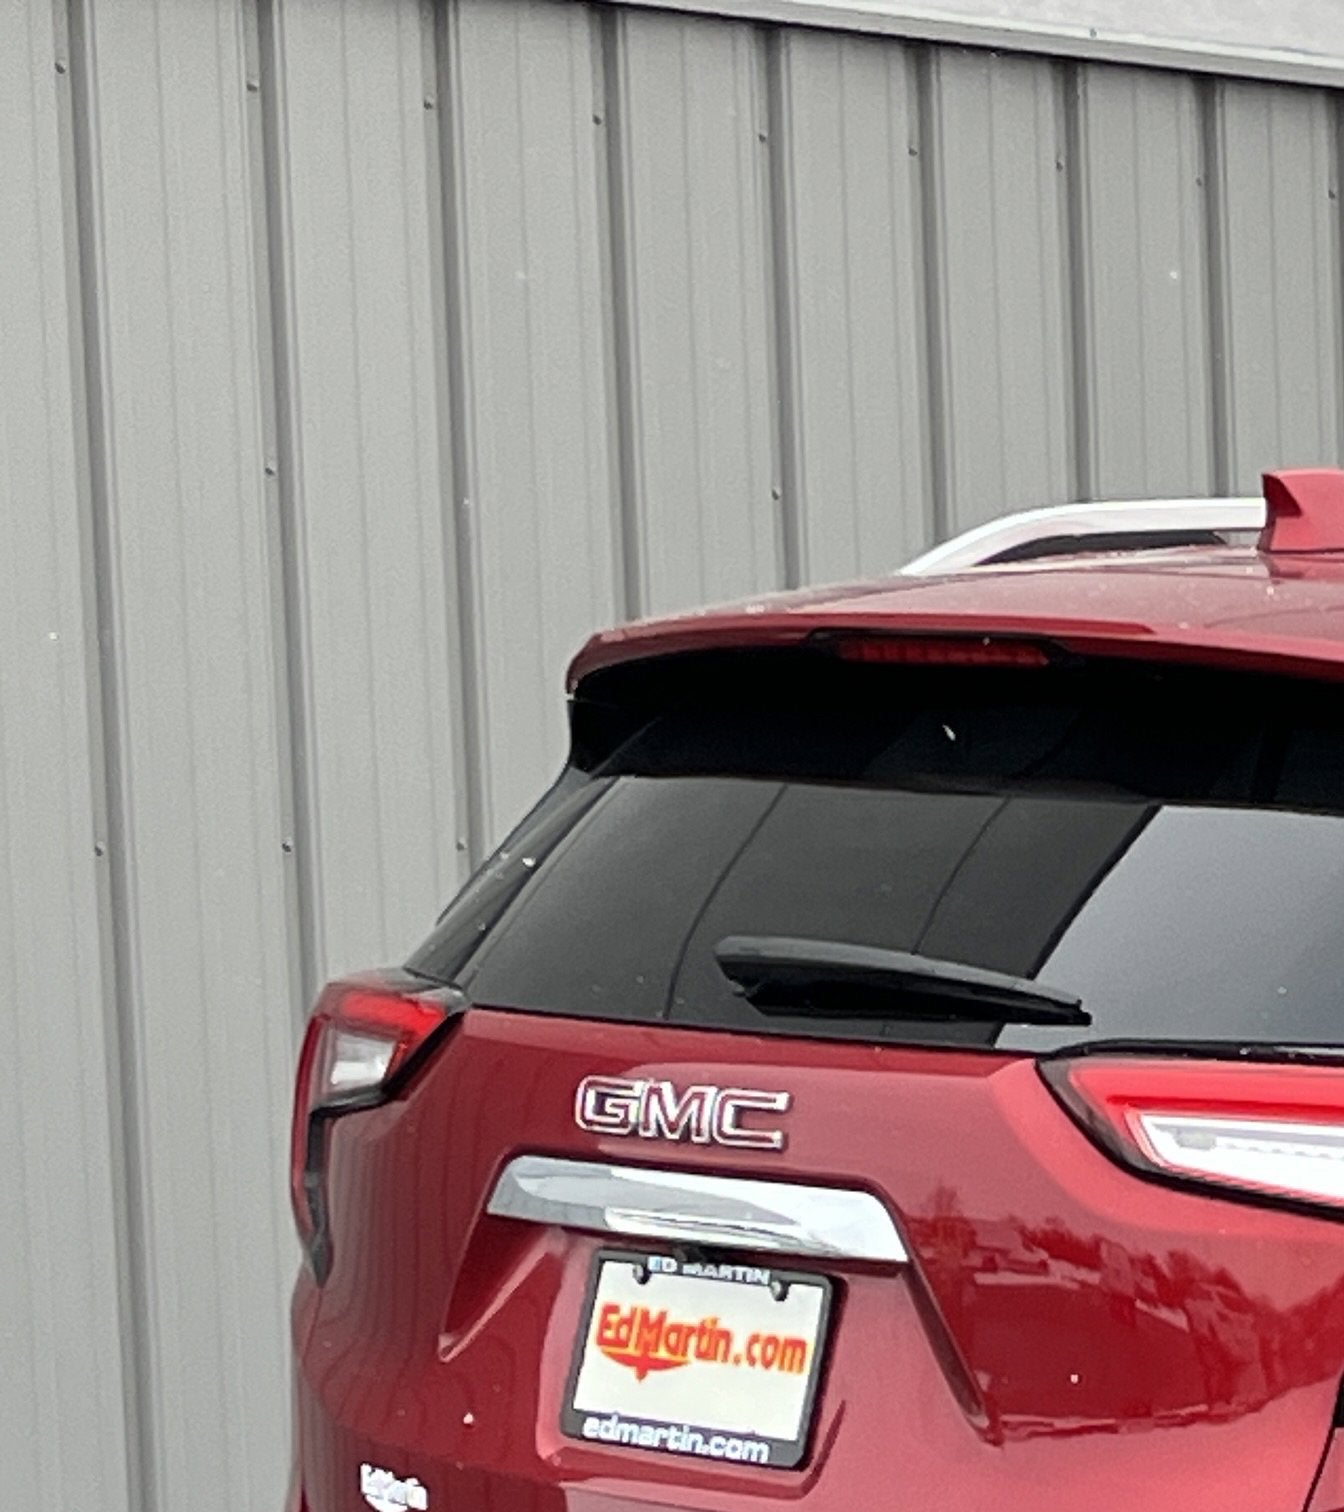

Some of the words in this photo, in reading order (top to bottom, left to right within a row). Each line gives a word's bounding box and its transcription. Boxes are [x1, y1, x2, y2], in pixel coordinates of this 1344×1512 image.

[575, 1075, 791, 1149] GMC
[647, 1256, 678, 1273] ED
[682, 1263, 771, 1287] MARTIN
[597, 1303, 808, 1375] EdMartin.com
[582, 1415, 770, 1464] edmartin.com
